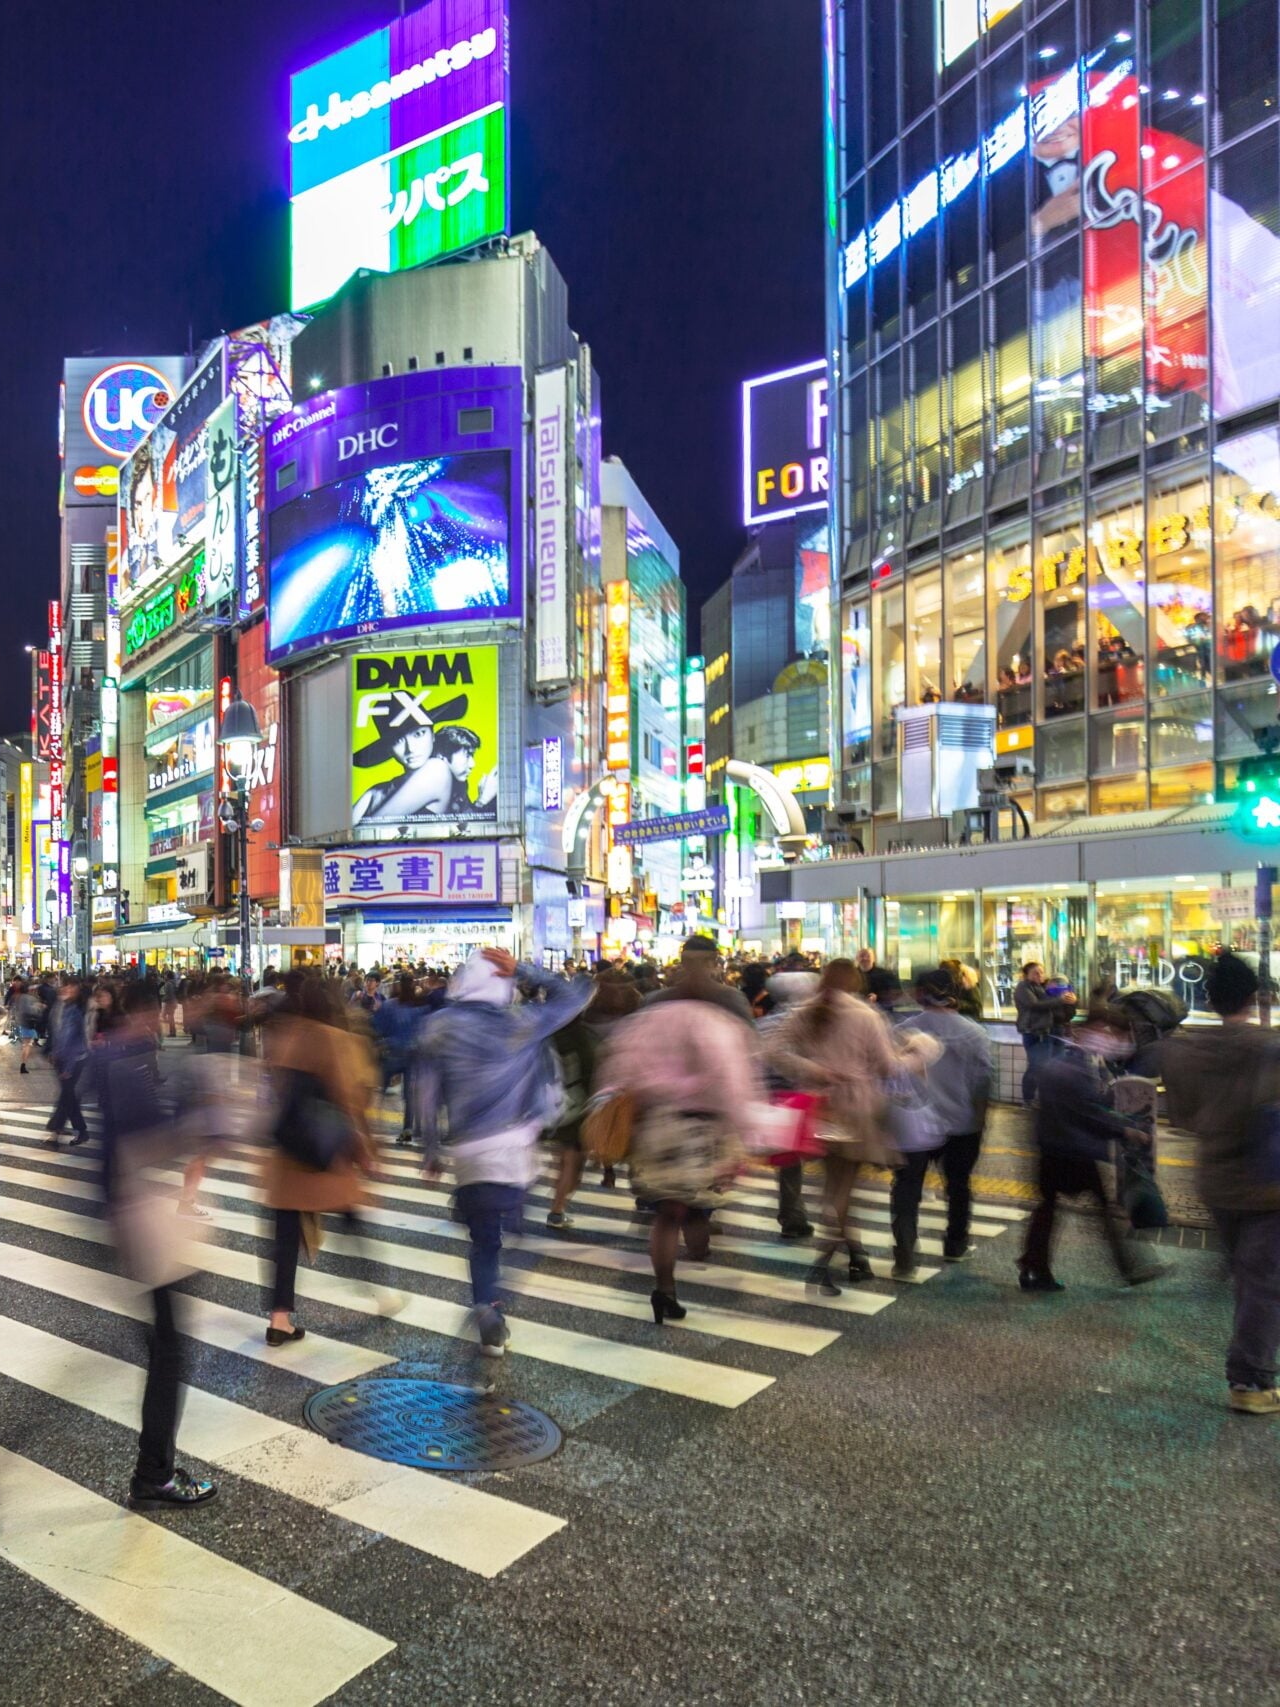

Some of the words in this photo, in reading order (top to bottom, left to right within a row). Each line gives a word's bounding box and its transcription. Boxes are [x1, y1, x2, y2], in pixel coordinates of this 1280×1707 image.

[94, 387, 162, 432] UC
[292, 402, 336, 434] Channel
[337, 423, 399, 461] DHC
[539, 405, 561, 510] Taisei
[539, 518, 558, 603] neon
[357, 622, 380, 634] DHC
[356, 652, 474, 691] DMM
[39, 652, 50, 756] KATE
[356, 689, 435, 728] FX
